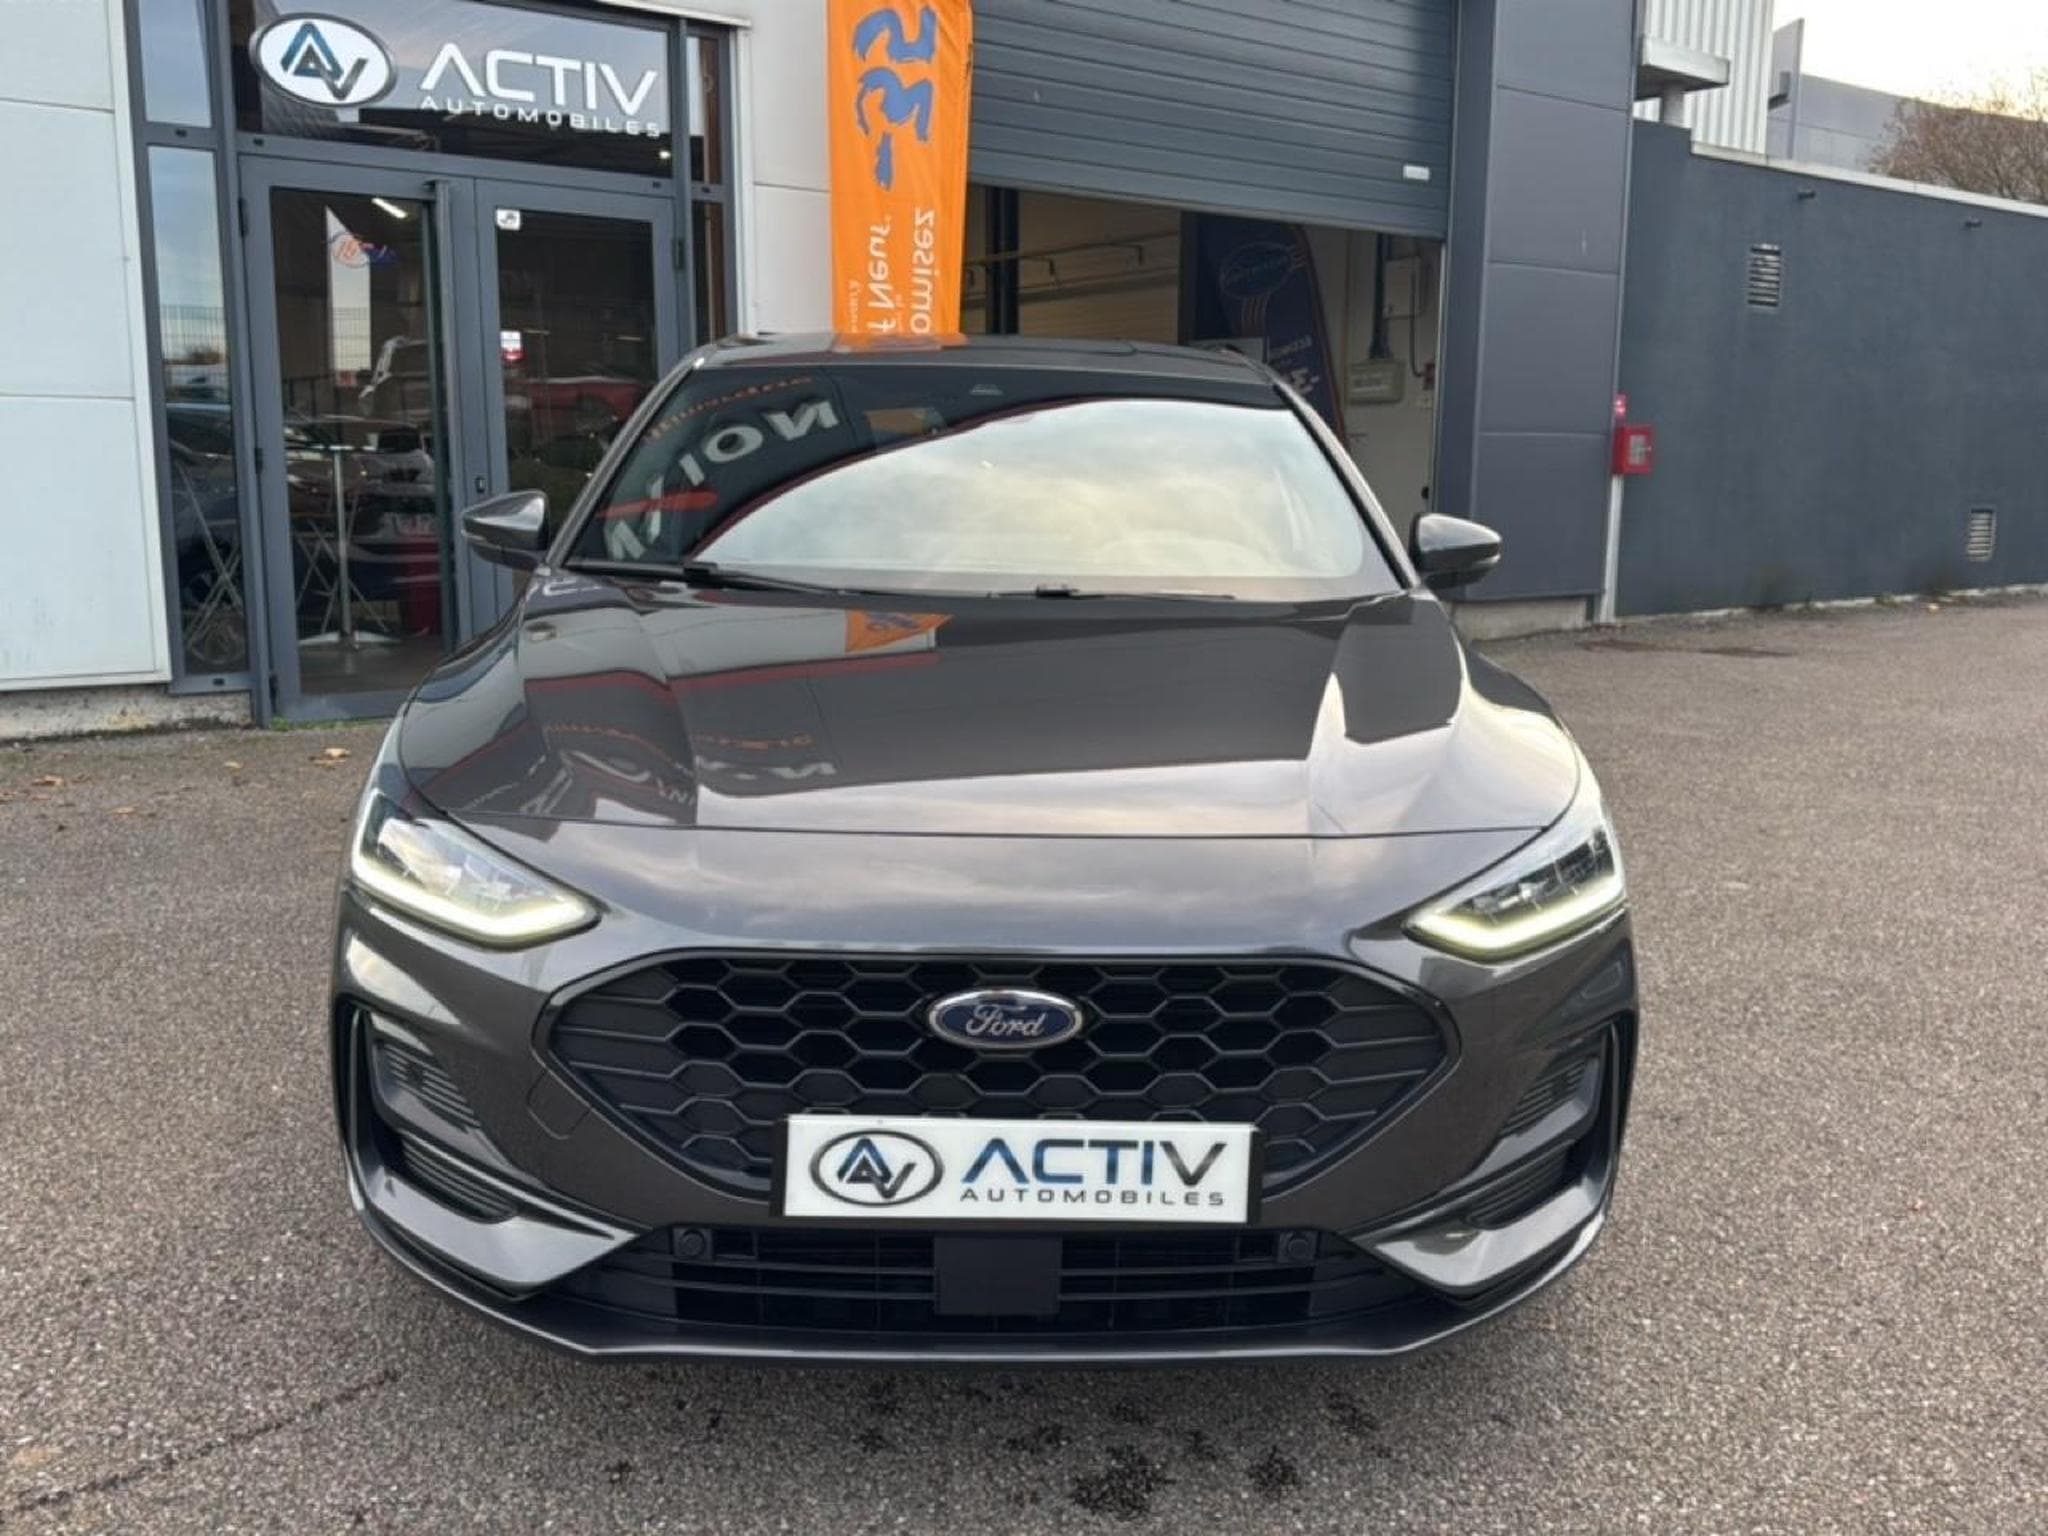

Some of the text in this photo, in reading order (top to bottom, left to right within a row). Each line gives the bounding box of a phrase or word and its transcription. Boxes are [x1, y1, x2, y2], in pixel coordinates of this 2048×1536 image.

[418, 42, 659, 116] ACTIV
[419, 95, 661, 139] AUTOMOBILES
[965, 1004, 1048, 1039] Ford
[960, 1137, 1228, 1187] ACTIV
[960, 1188, 1226, 1207] AUTOMOBILES
